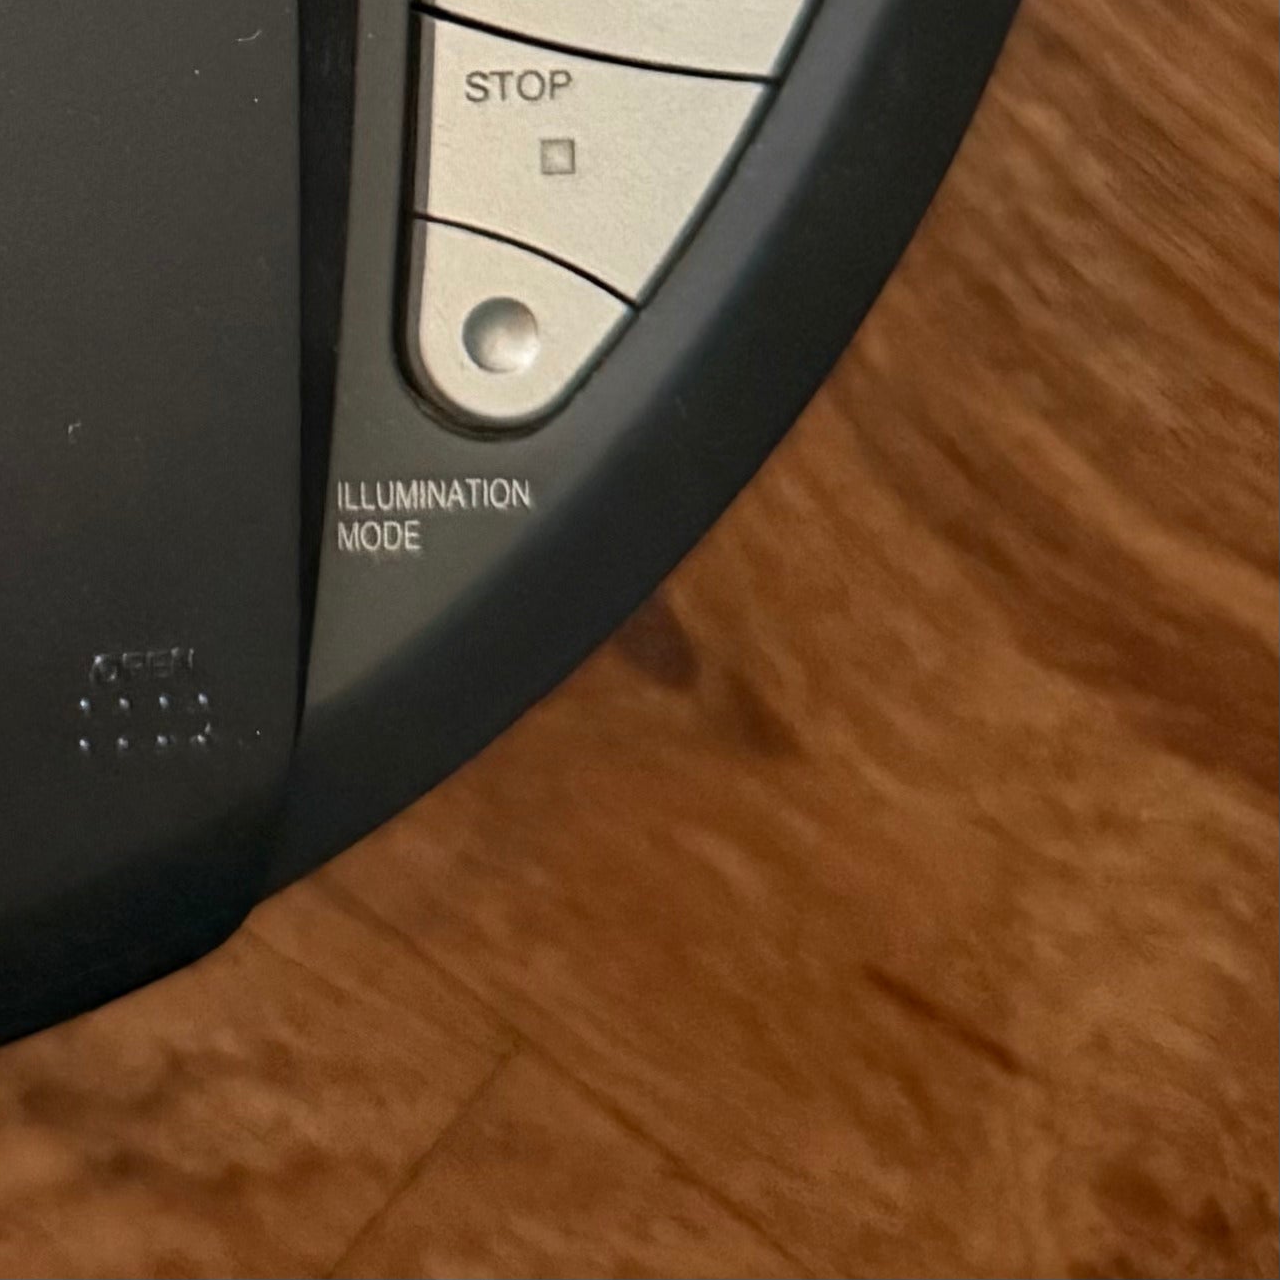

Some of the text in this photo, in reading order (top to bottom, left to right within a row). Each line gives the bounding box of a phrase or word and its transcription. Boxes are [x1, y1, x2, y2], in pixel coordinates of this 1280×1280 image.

[464, 71, 573, 102] STOP
[338, 479, 530, 511] ILLUMINATION
[338, 521, 421, 551] MODE
